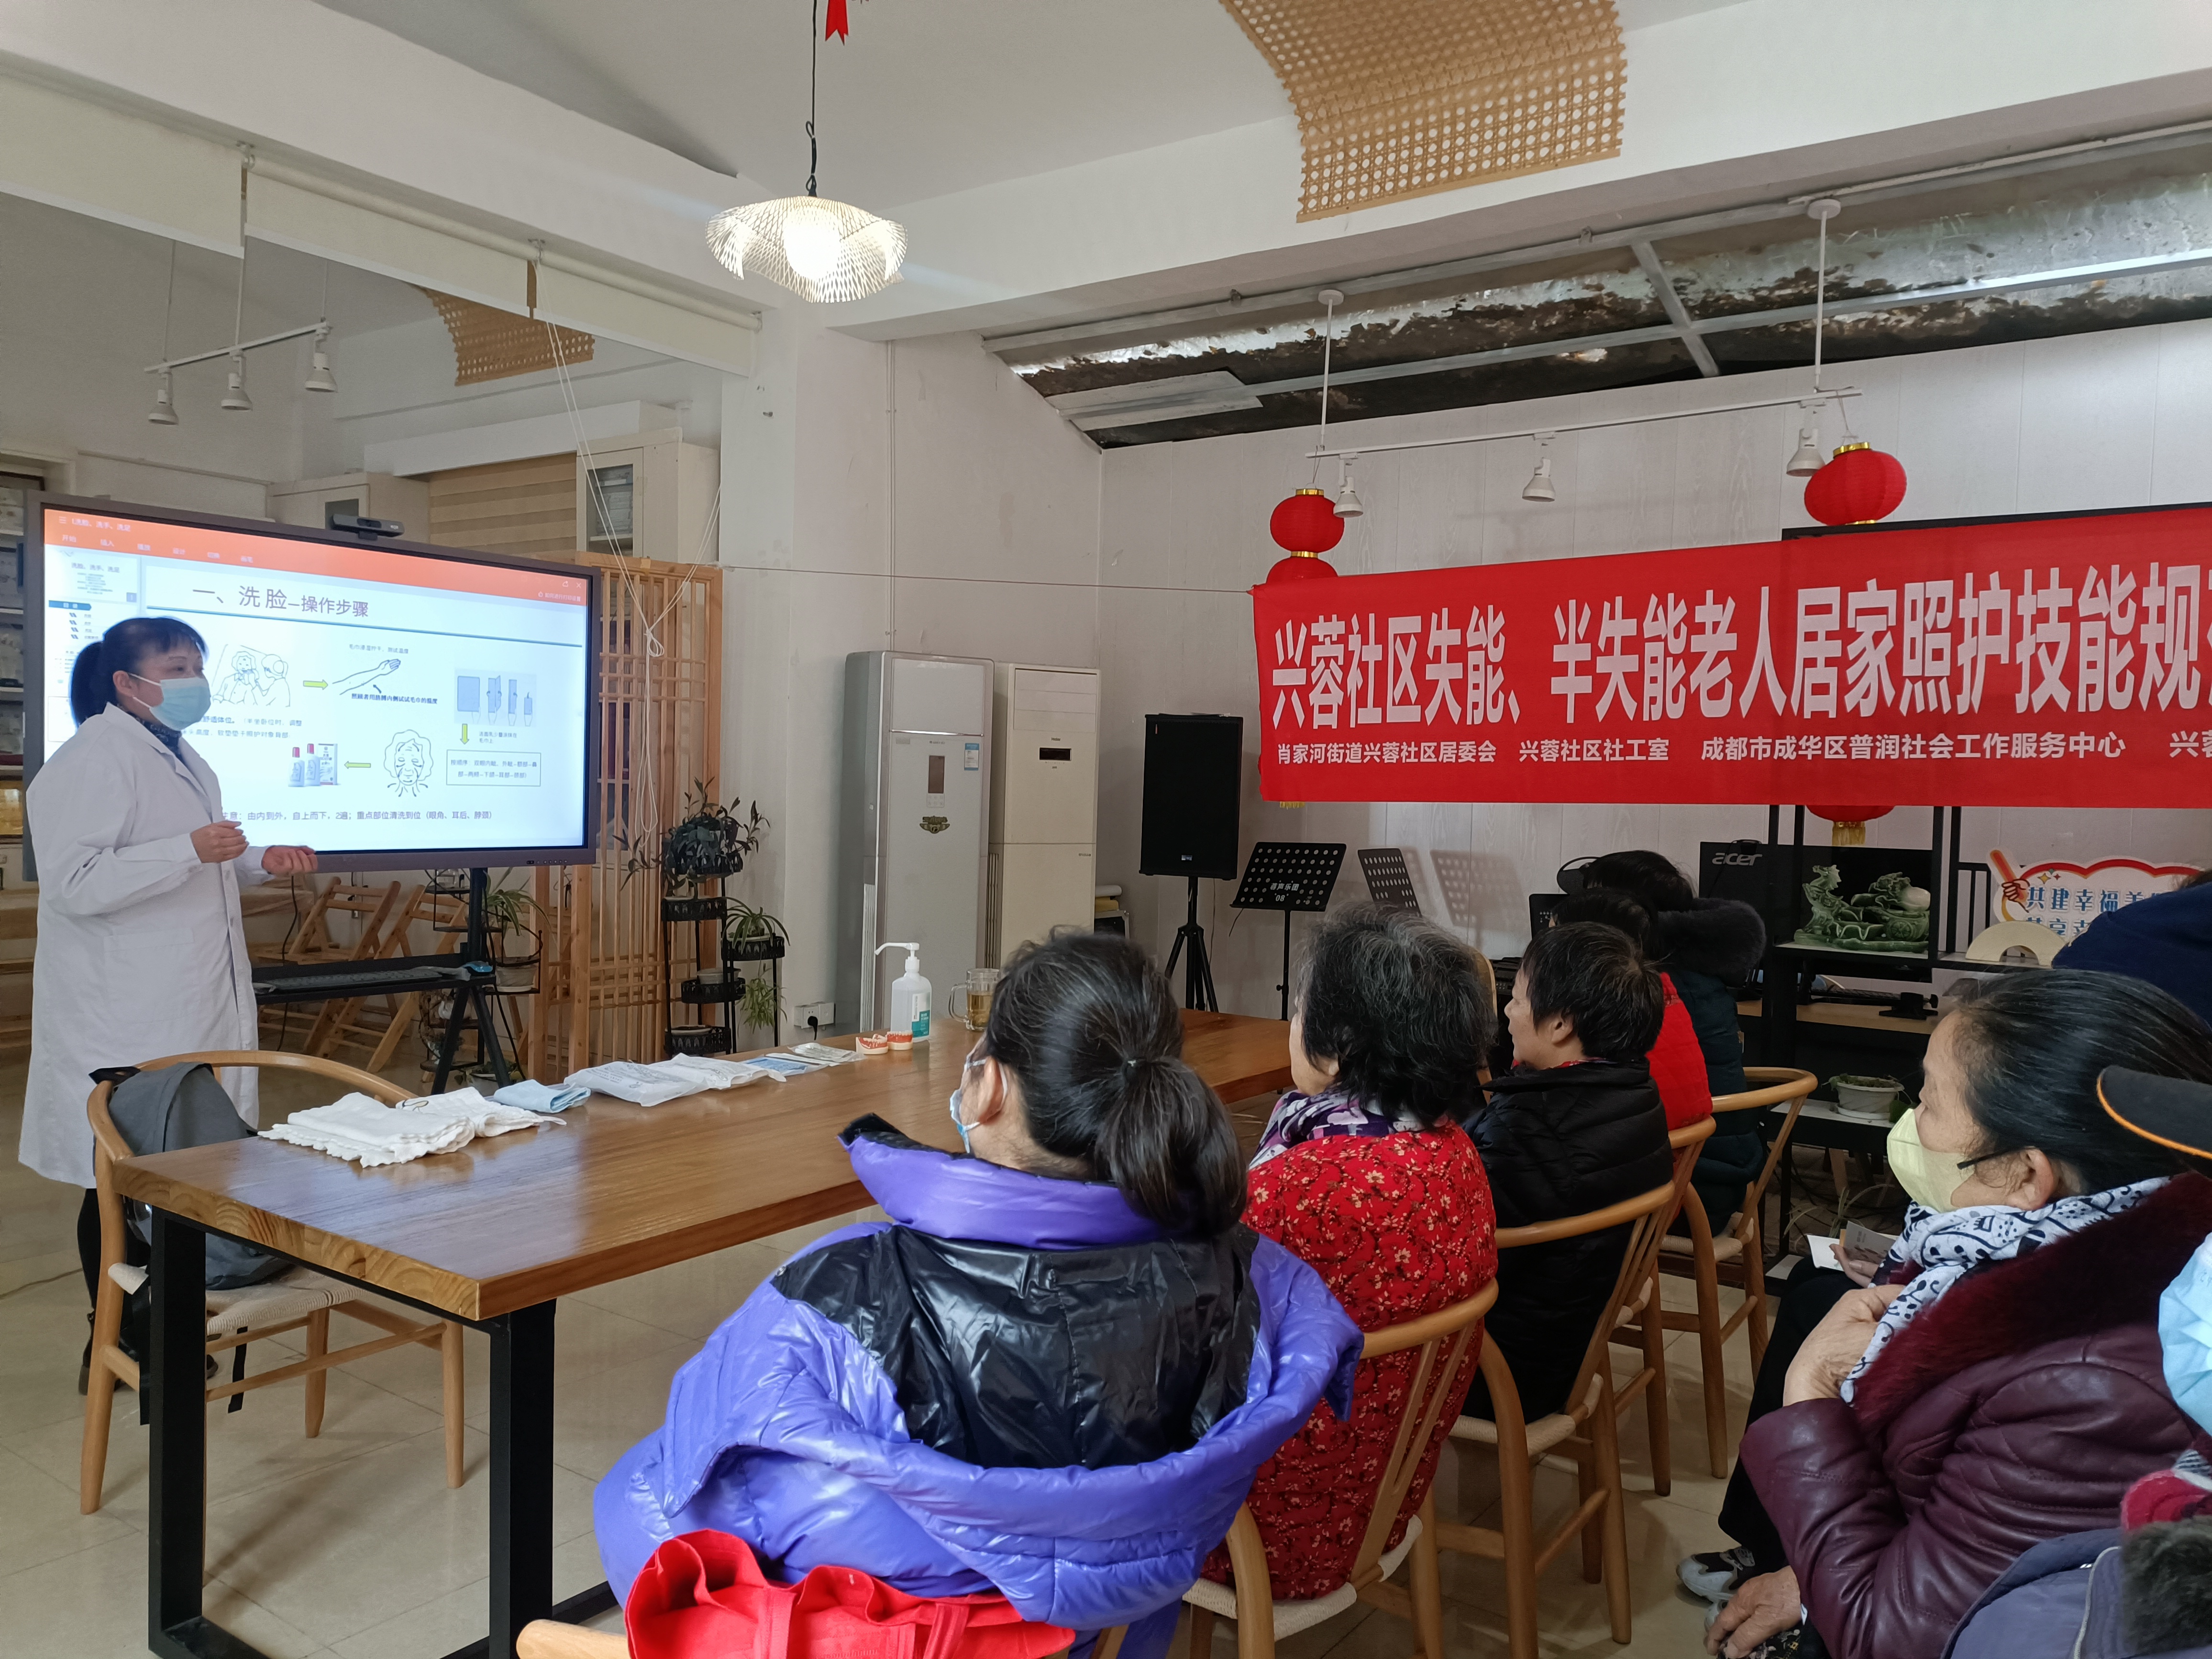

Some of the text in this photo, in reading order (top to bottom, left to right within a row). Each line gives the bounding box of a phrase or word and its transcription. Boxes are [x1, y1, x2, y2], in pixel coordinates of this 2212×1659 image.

[62, 534, 77, 543] 开始
[1272, 562, 2212, 730] 兴蓉社区失能、半失能老人居家照护技能规
[1277, 739, 1496, 764] 肖家河街道兴蓉社区居委会
[1519, 737, 1669, 763] 兴蓉社区社工室
[1701, 731, 2126, 761] 成都市成华区普润社会工作服务中心
[1712, 852, 1763, 866] acer
[2026, 886, 2161, 913] 共建幸福美
